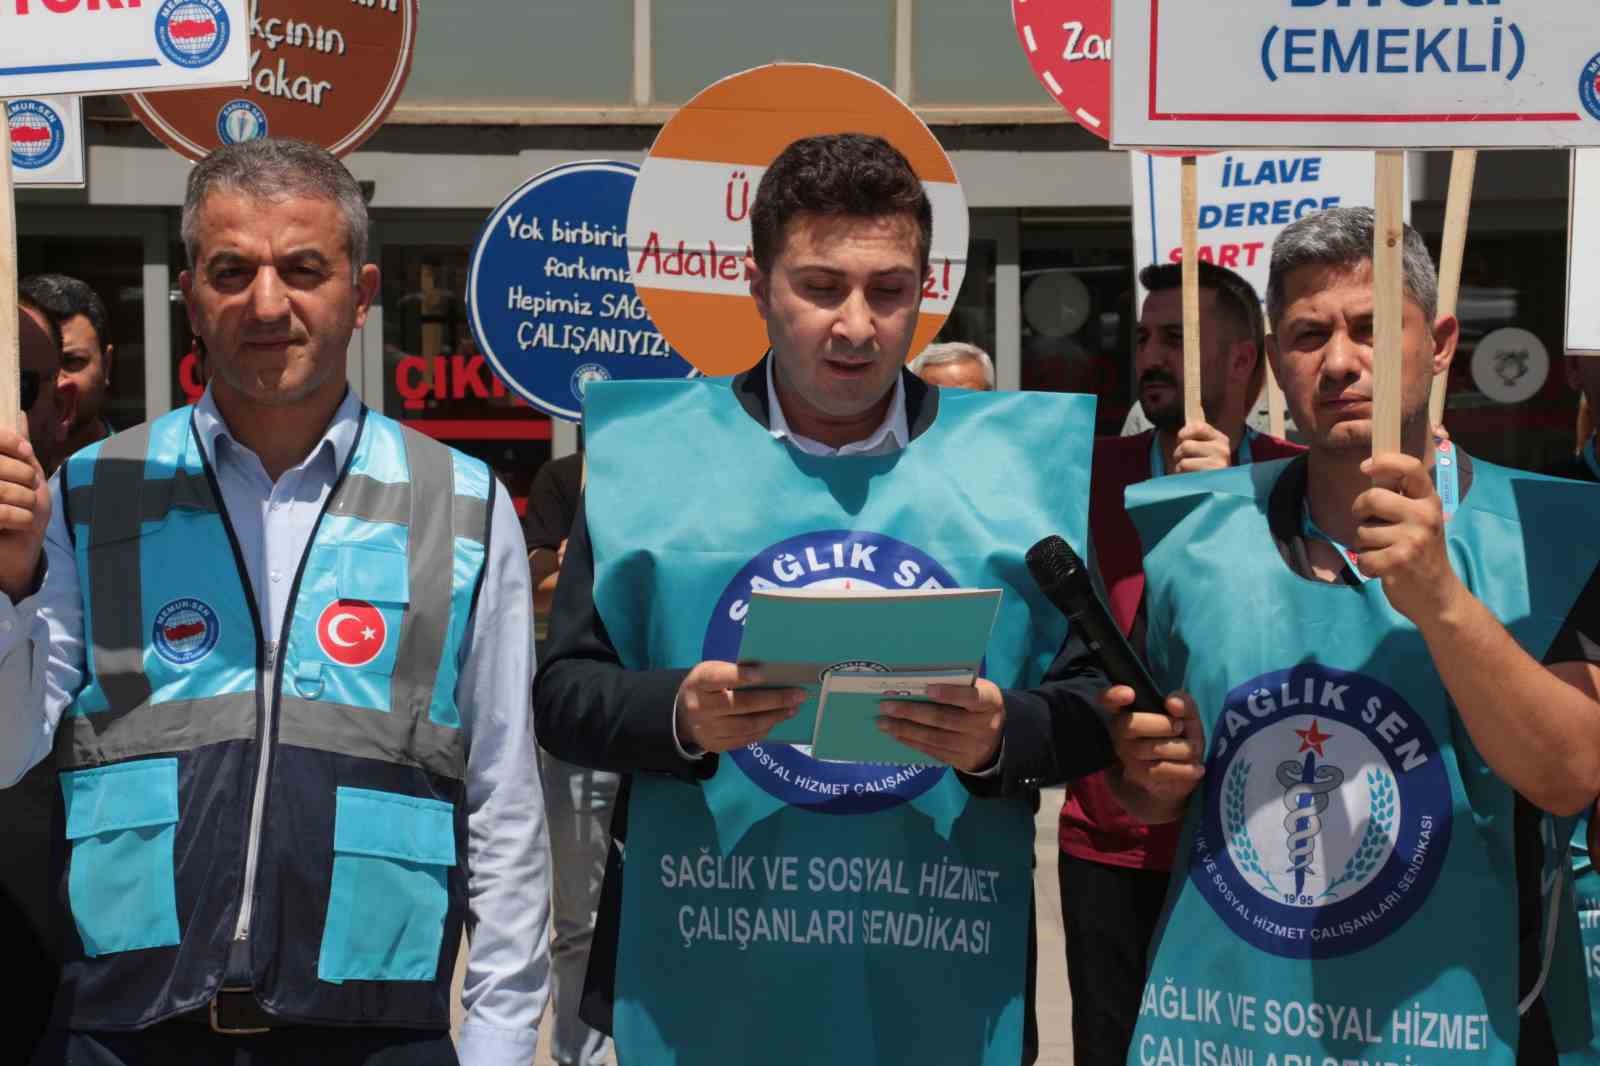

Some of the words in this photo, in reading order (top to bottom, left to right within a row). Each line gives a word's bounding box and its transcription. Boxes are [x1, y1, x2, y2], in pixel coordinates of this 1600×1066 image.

[249, 0, 345, 54] kçının
[1261, 17, 1525, 82] (EMEKLİ)
[1221, 156, 1321, 188] İLAVE
[507, 213, 544, 240] Yok
[508, 286, 593, 318] Hepimiz
[517, 321, 670, 358] ÇALIŞANIYIZ!
[396, 355, 528, 410] ÇIK
[1361, 696, 1428, 771] SEN
[794, 775, 849, 796] HİZMET
[661, 848, 755, 891] SAĞLIK
[763, 857, 798, 891] VE
[808, 857, 910, 895] SOSYAL
[919, 856, 999, 903] HİZMET
[1212, 873, 1250, 921] SOSYAL
[1252, 914, 1306, 940] HİZMET
[1397, 815, 1433, 893] SENDİKASI
[678, 905, 853, 950] ÇALIŞANLARI
[863, 907, 991, 955] SENDİKASI
[1140, 976, 1222, 1025] AĞLIK
[1228, 992, 1256, 1032] VE
[1264, 1000, 1382, 1044] SOSYAL
[1392, 1002, 1489, 1050] HİZMET
